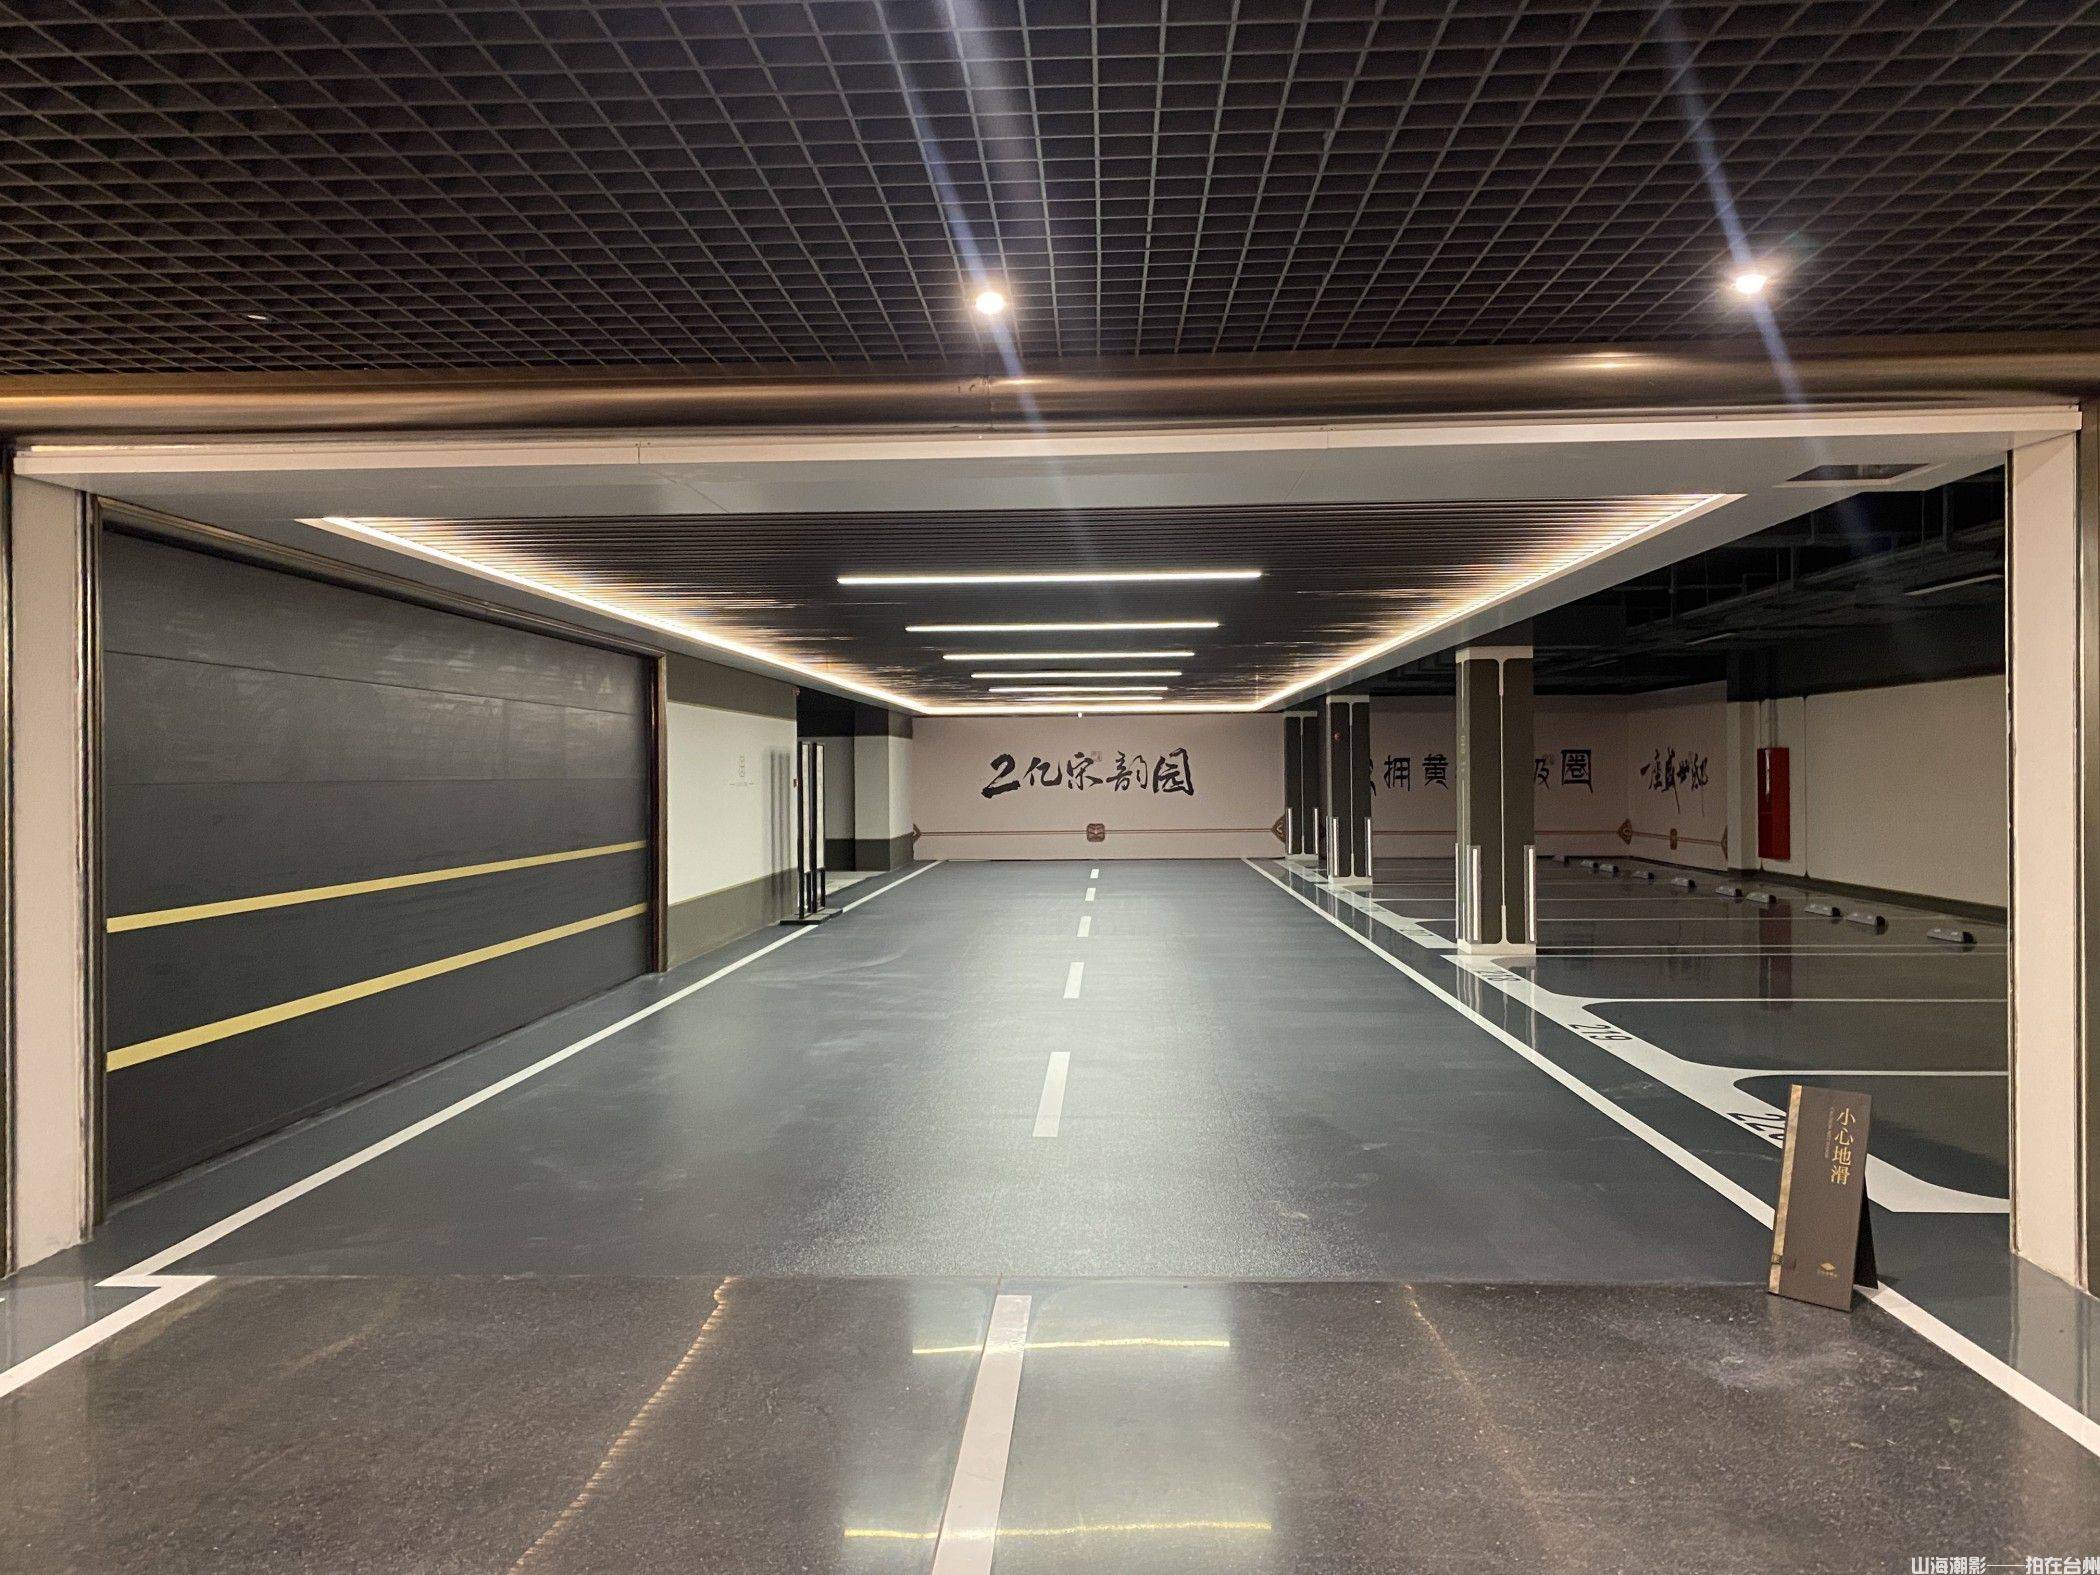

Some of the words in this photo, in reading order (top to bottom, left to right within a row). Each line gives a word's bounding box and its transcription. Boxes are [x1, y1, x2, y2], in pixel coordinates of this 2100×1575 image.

[1567, 1023, 1633, 1041] 219
[1830, 1107, 1857, 1186] 小心地滑
